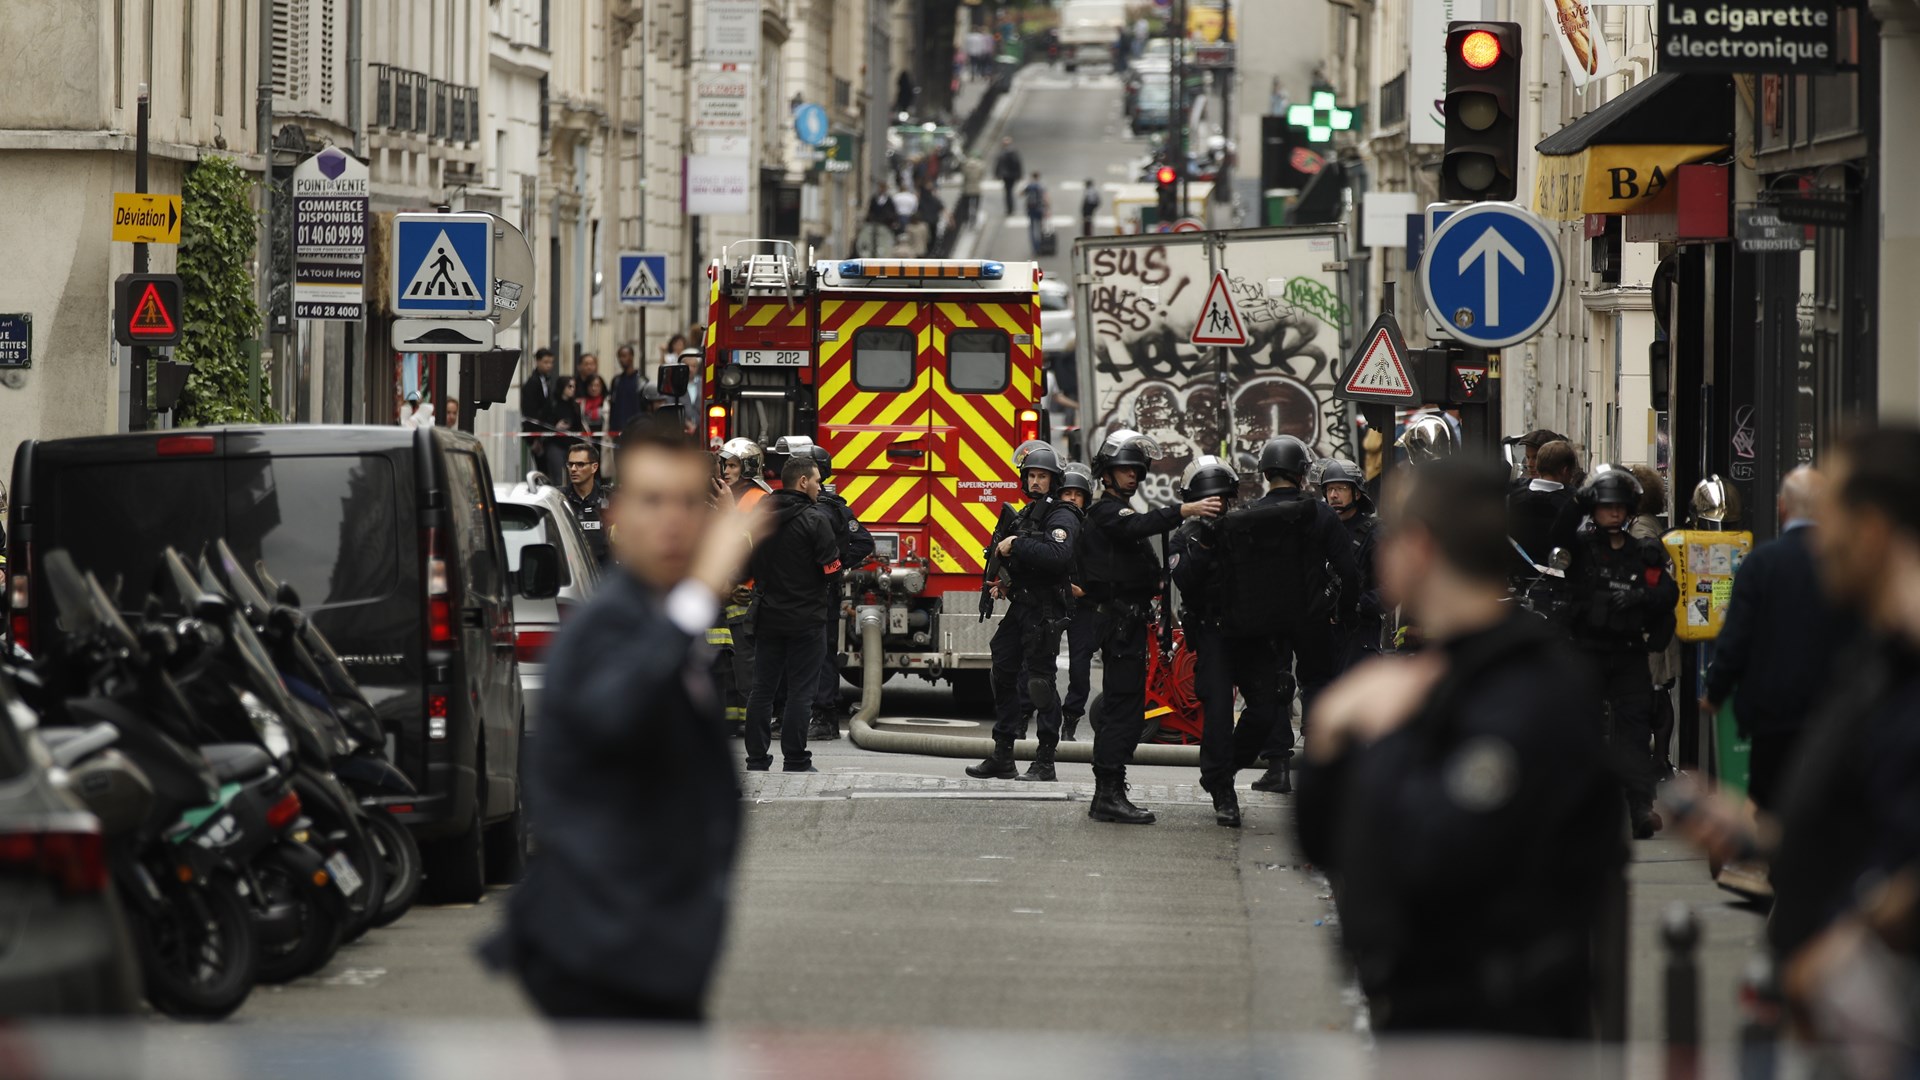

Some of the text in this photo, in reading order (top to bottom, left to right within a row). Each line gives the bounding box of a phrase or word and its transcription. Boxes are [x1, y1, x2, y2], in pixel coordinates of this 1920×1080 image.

[1571, 4, 1590, 19] vie
[1668, 3, 1829, 33] La cigarette
[1666, 34, 1829, 65] électronique
[296, 179, 327, 192] POINT
[335, 179, 366, 192] VENTE
[298, 200, 364, 212] COMMERCE
[116, 207, 165, 227] Déviation
[298, 212, 364, 224] DISPONIBLE
[298, 225, 364, 245] 01 40 60 99 99
[1764, 227, 1777, 238] DE
[1742, 237, 1801, 250] CURIOSITÉS
[1094, 245, 1171, 285] SUS
[297, 269, 309, 277] LA
[310, 269, 334, 278] TOUR
[297, 305, 360, 317] 01 40 28 4000
[0, 341, 26, 349] ETITES
[745, 351, 800, 364] PS 202
[958, 481, 1018, 489] SAPEURS-POMPIERS
